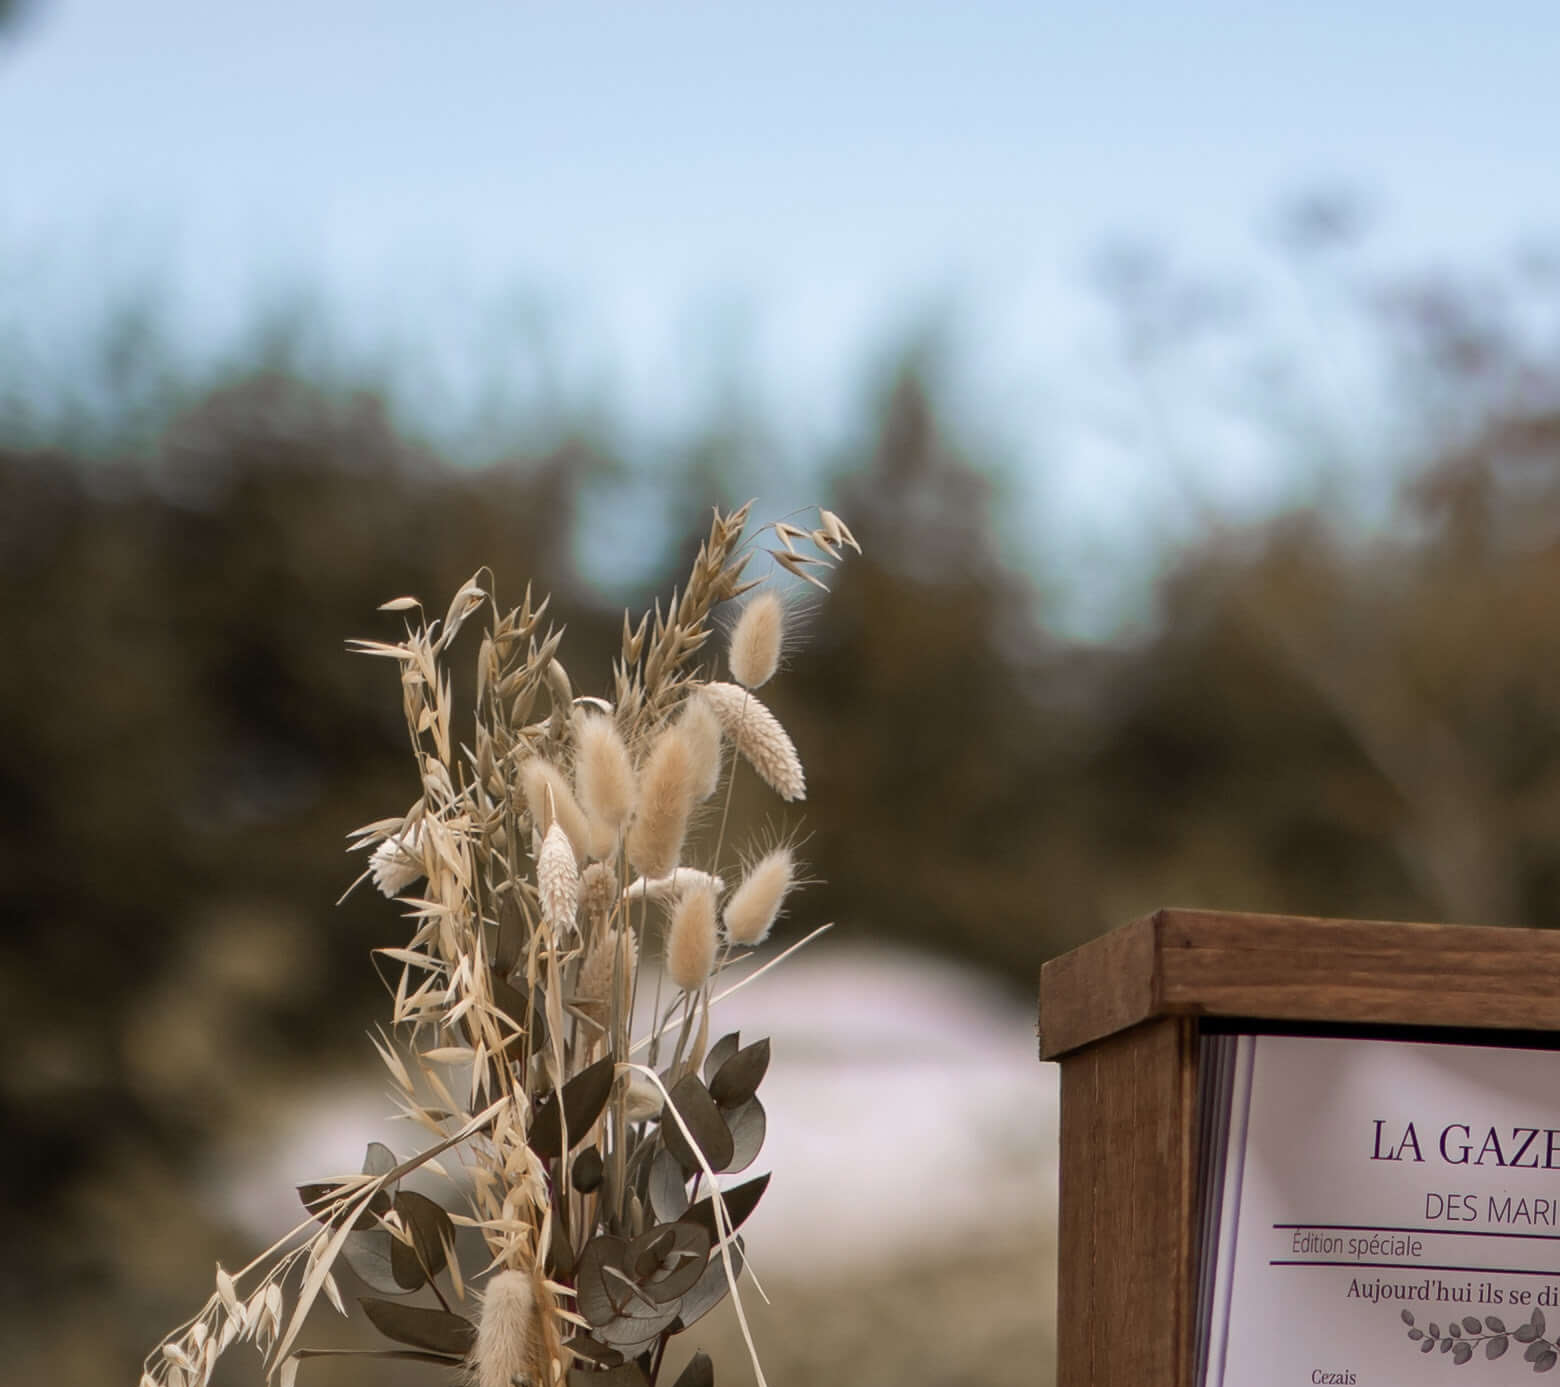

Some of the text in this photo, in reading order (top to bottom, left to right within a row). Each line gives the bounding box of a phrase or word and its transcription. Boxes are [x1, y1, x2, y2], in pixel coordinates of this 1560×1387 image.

[1370, 1119, 1425, 1162] LA
[1425, 1192, 1478, 1222] DES
[1292, 1230, 1424, 1260] Édition spéciale
[1346, 1278, 1472, 1304] Aujourd'hui
[1478, 1282, 1503, 1304] ils
[1508, 1289, 1532, 1305] se
[1311, 1368, 1356, 1385] Cezais
